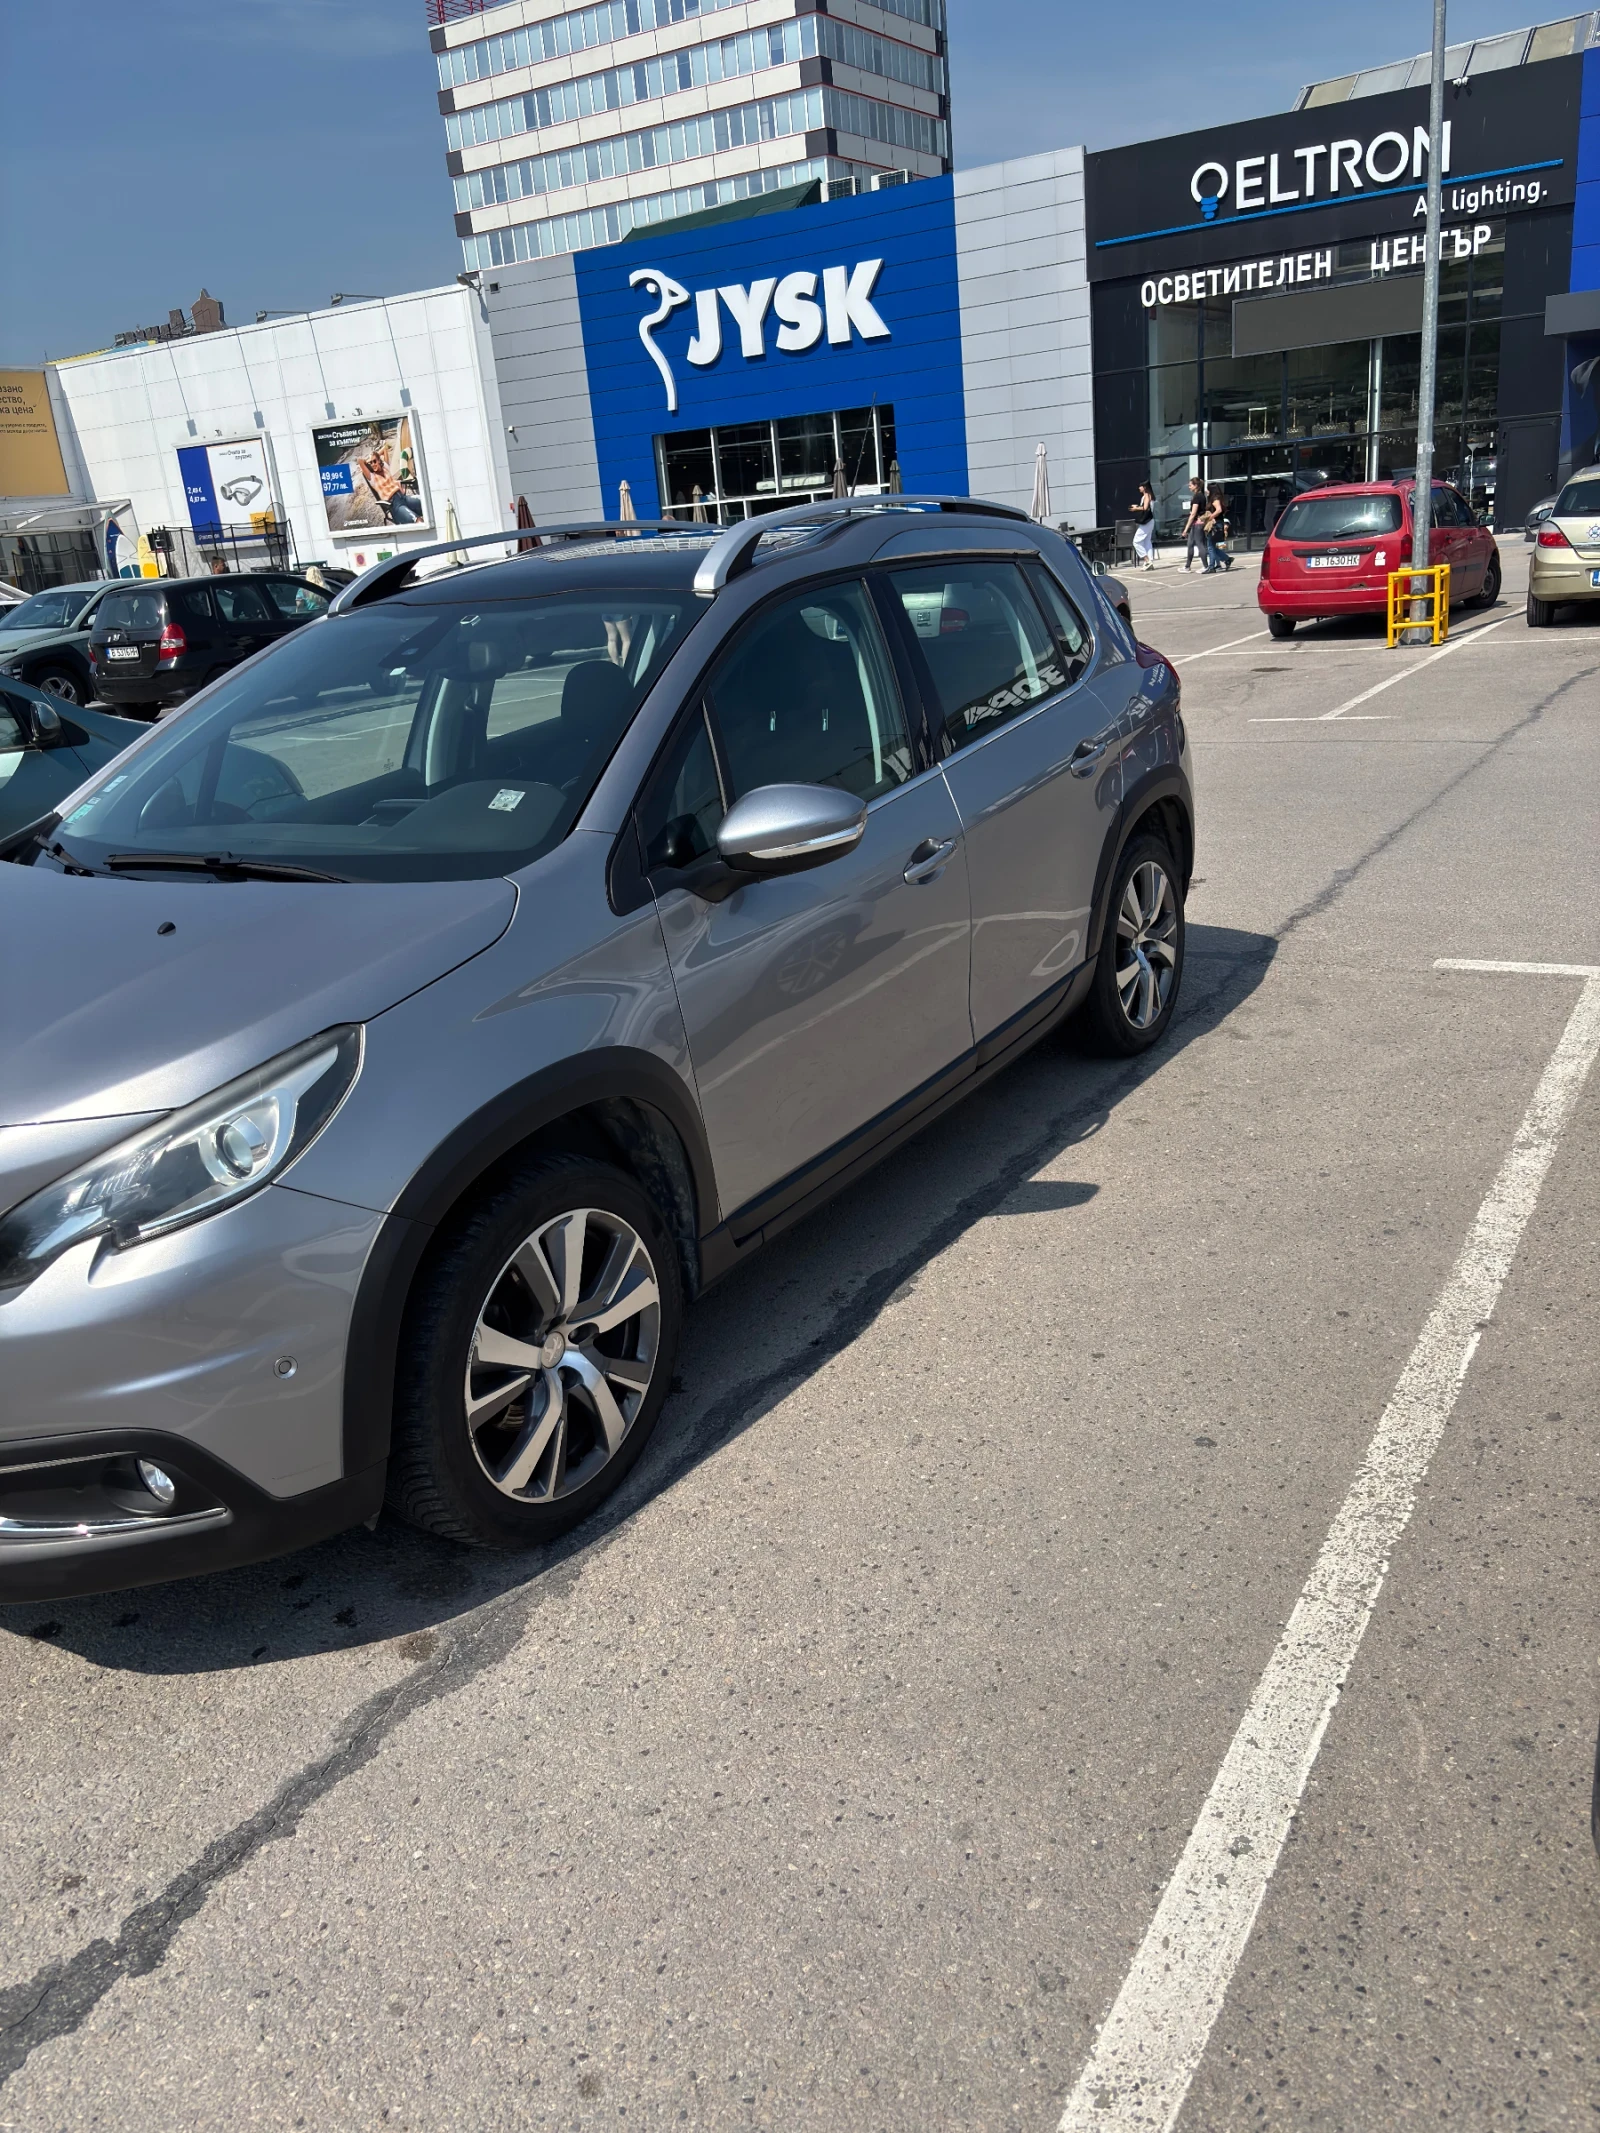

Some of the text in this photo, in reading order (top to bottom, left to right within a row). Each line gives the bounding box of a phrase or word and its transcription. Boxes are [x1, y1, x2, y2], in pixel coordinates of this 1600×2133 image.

[1413, 180, 1548, 217] Al lighting.
[1141, 225, 1492, 308] ОСВЕТИТЕЛЕН ЦЕНТЪР
[686, 258, 892, 365] JYSK
